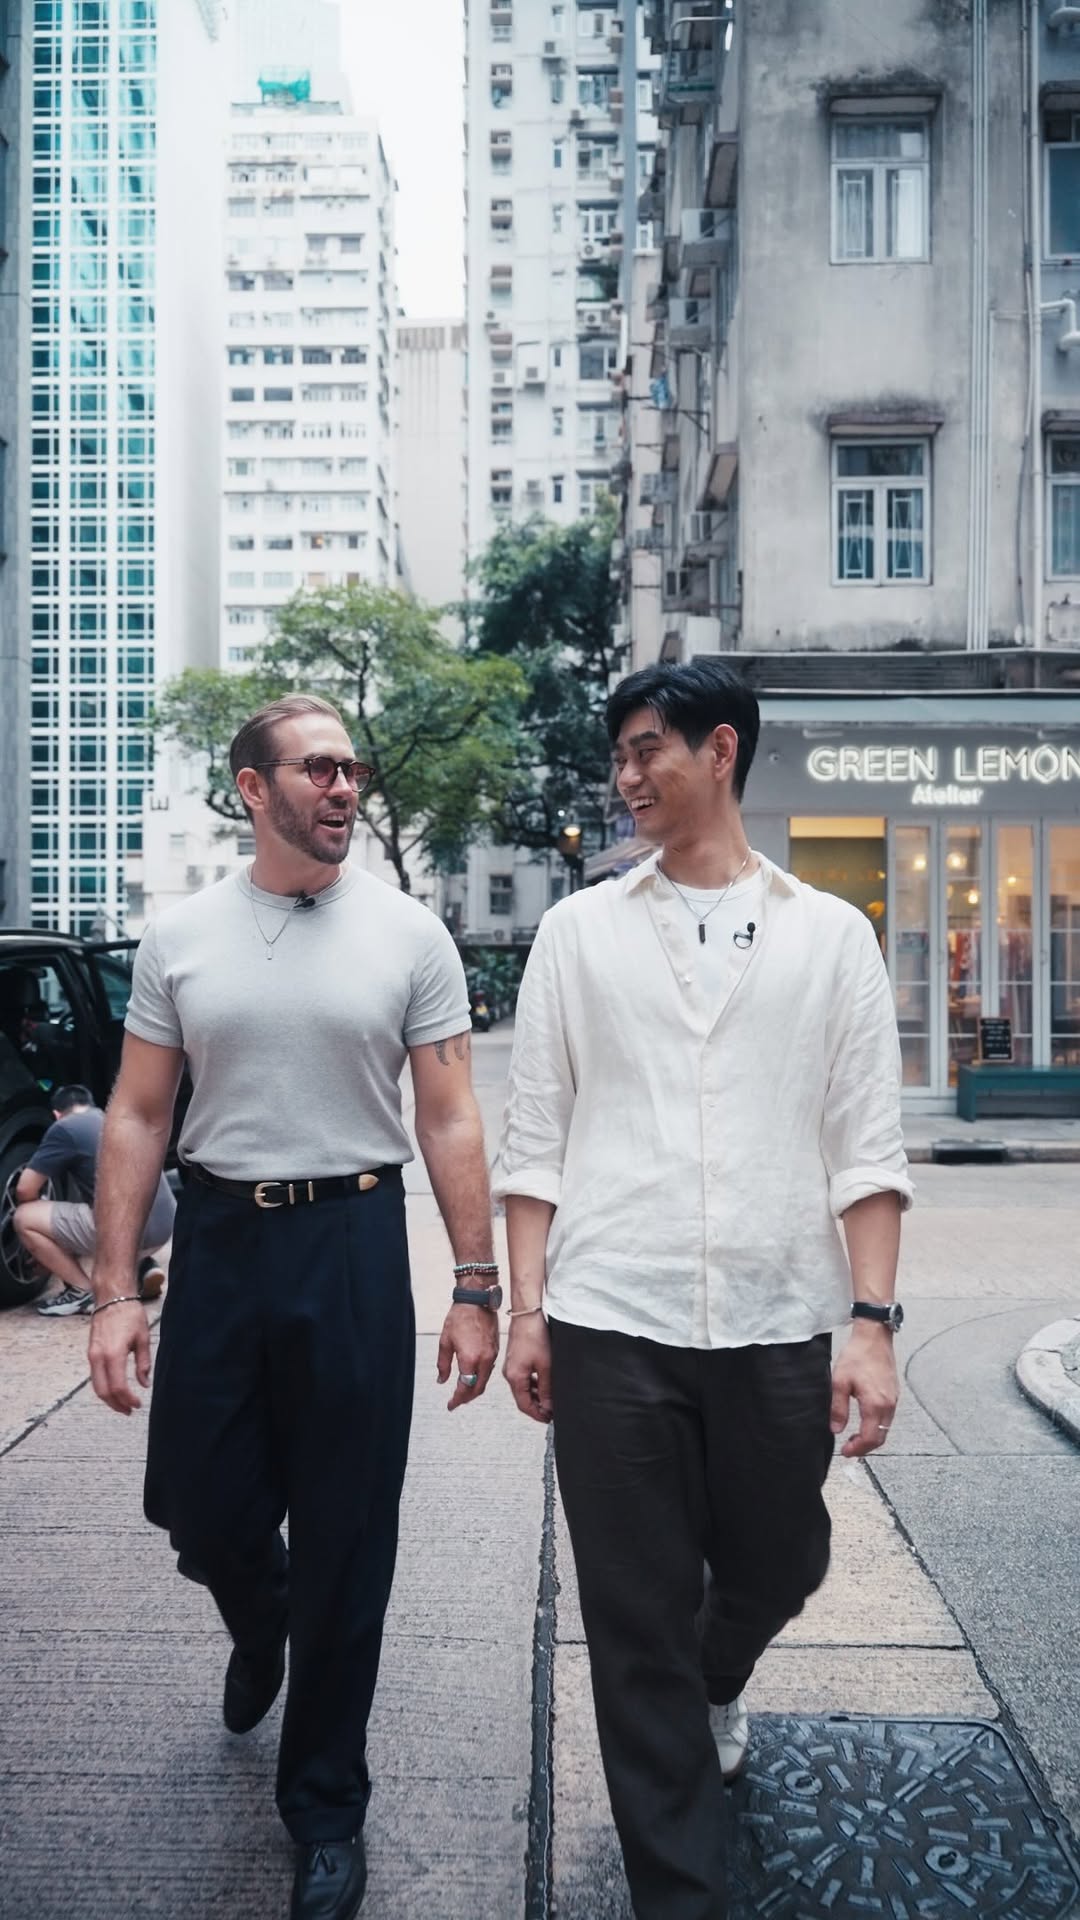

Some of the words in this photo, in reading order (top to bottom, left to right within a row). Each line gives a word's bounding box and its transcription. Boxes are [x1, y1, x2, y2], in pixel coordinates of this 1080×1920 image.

[806, 745, 939, 782] GREEN
[955, 743, 1080, 784] LEMON
[911, 784, 984, 805] Atelier
